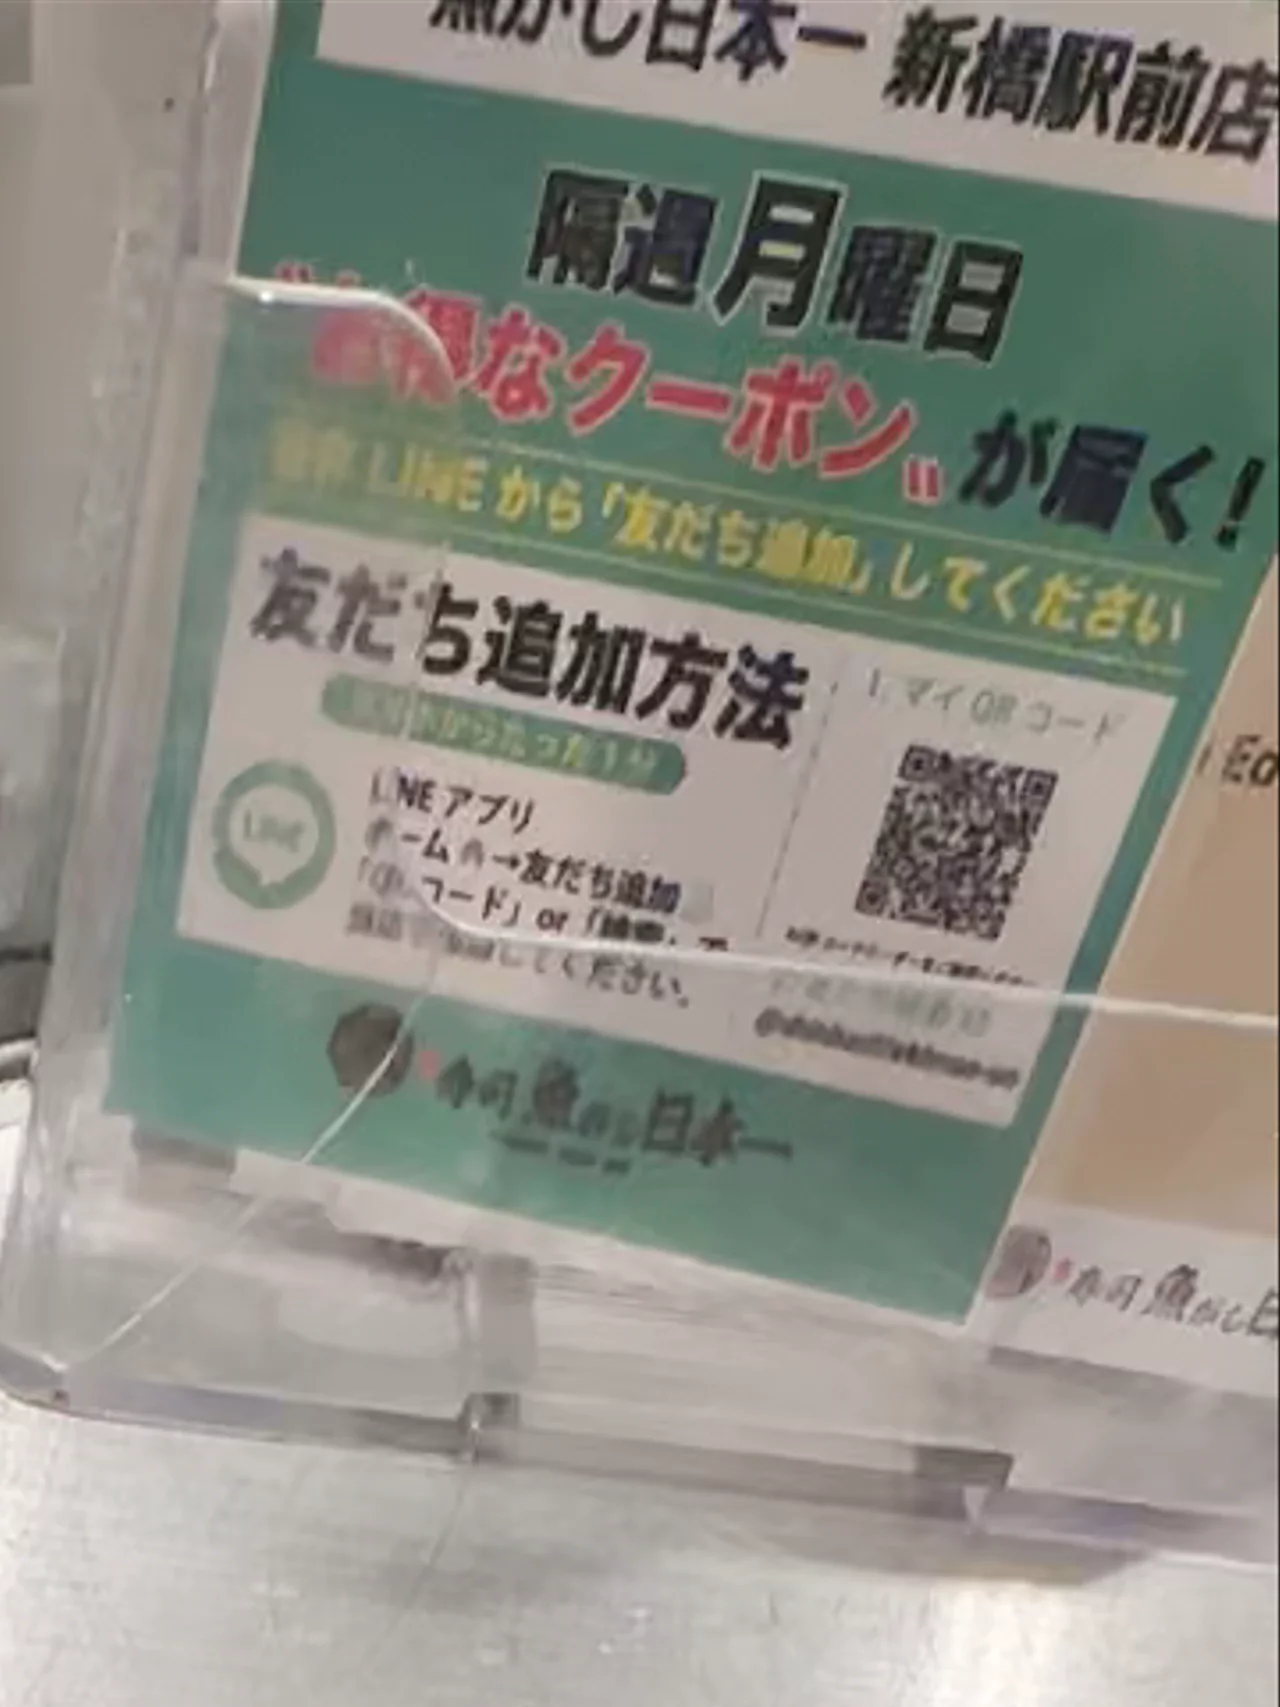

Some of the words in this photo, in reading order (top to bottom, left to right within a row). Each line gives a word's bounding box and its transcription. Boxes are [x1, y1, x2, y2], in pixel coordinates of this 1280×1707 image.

[883, 8, 1279, 162] 新橋駅前店
[250, 549, 811, 754] 友だち追加方法
